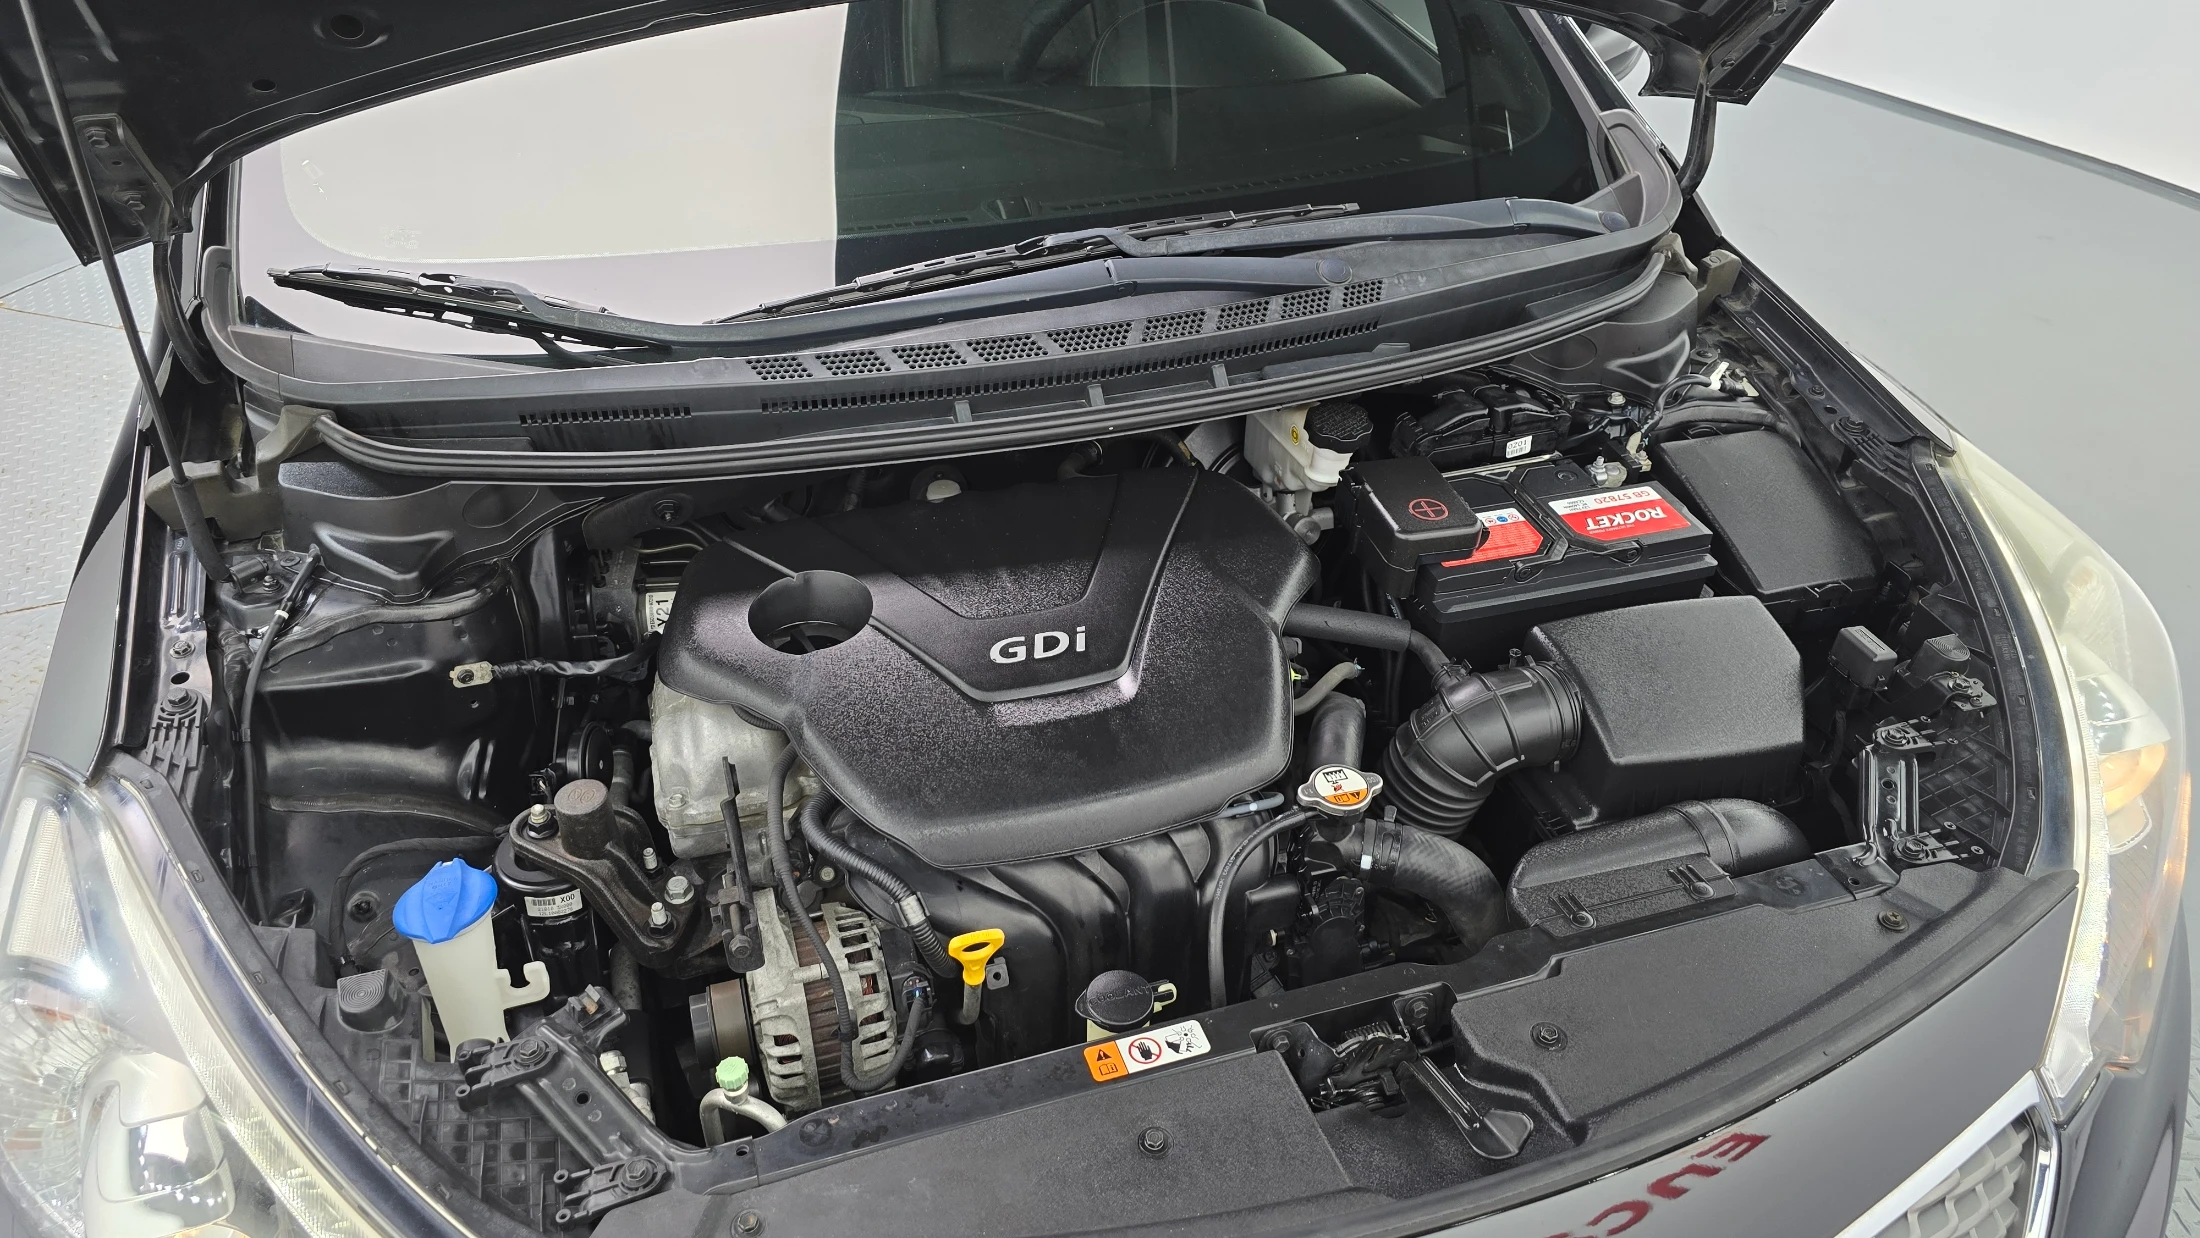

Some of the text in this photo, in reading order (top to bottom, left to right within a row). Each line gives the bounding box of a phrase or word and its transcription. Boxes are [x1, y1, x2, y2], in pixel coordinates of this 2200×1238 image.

[1507, 440, 1527, 449] 0201
[1593, 493, 1631, 505] 57820
[1633, 490, 1651, 498] GB
[1585, 506, 1668, 531] ROCKET
[990, 625, 1086, 664] GDi
[560, 893, 576, 904] X00
[1089, 984, 1151, 1007] COOLANT
